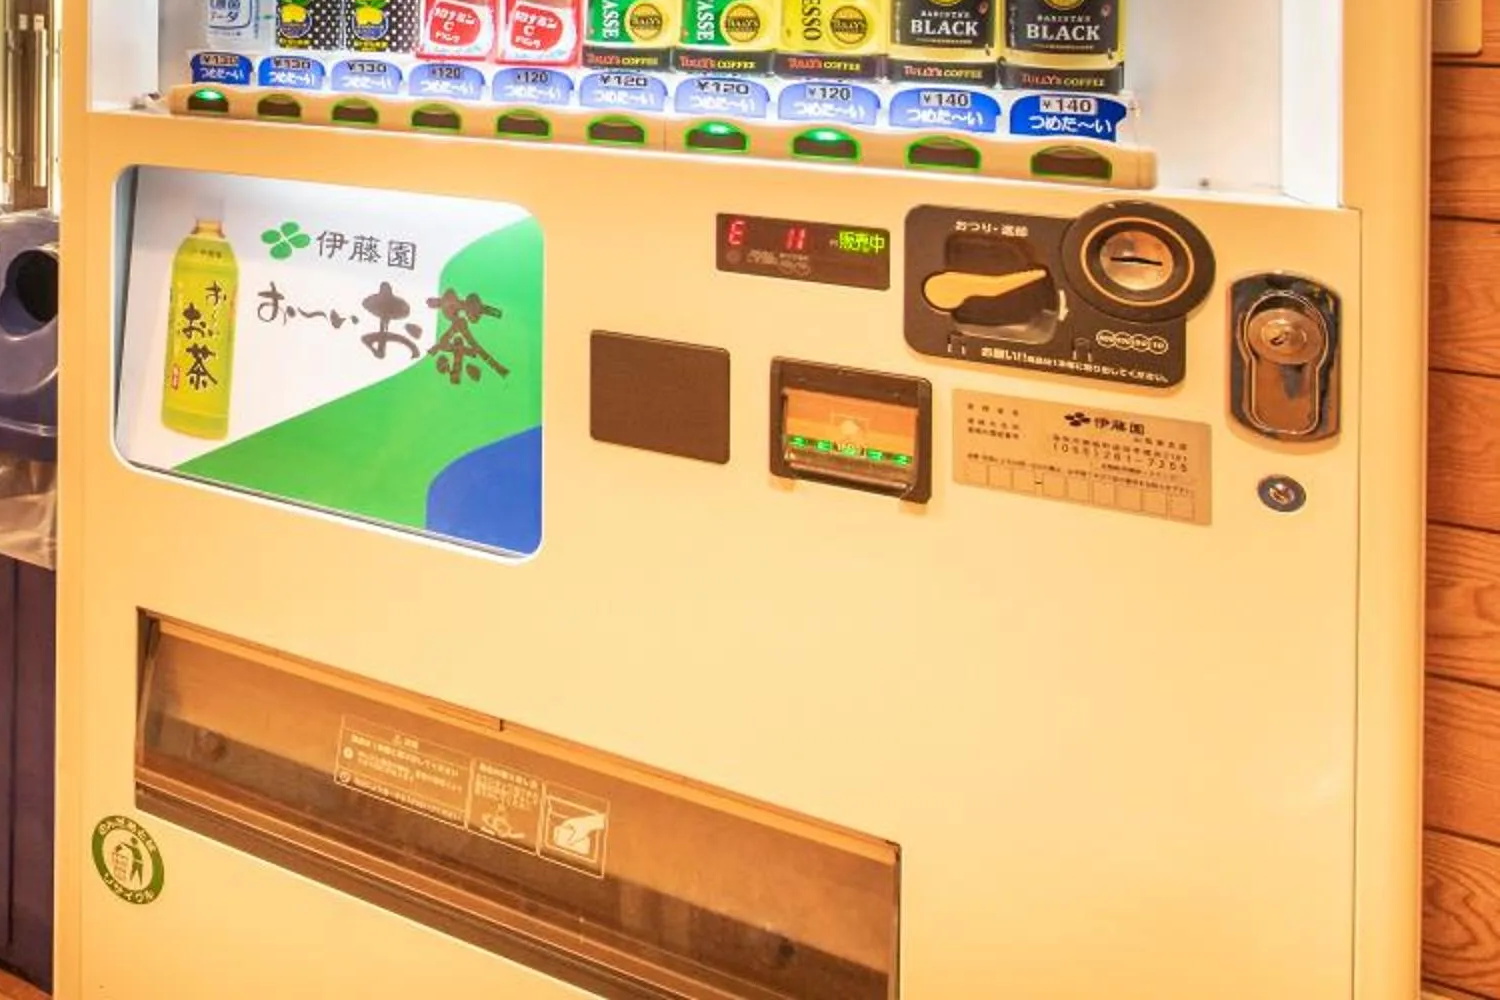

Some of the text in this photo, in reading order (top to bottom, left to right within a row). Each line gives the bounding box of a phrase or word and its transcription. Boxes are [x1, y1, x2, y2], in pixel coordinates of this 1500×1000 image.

[911, 20, 979, 36] BLACK
[1026, 24, 1100, 41] BLACK
[601, 75, 648, 88] ¥120
[699, 80, 749, 95] ¥120
[808, 86, 850, 101] ¥120
[923, 92, 969, 107] ¥140
[1042, 98, 1092, 113] ¥140
[316, 230, 417, 270] 伊藤園
[182, 302, 218, 390] お茶
